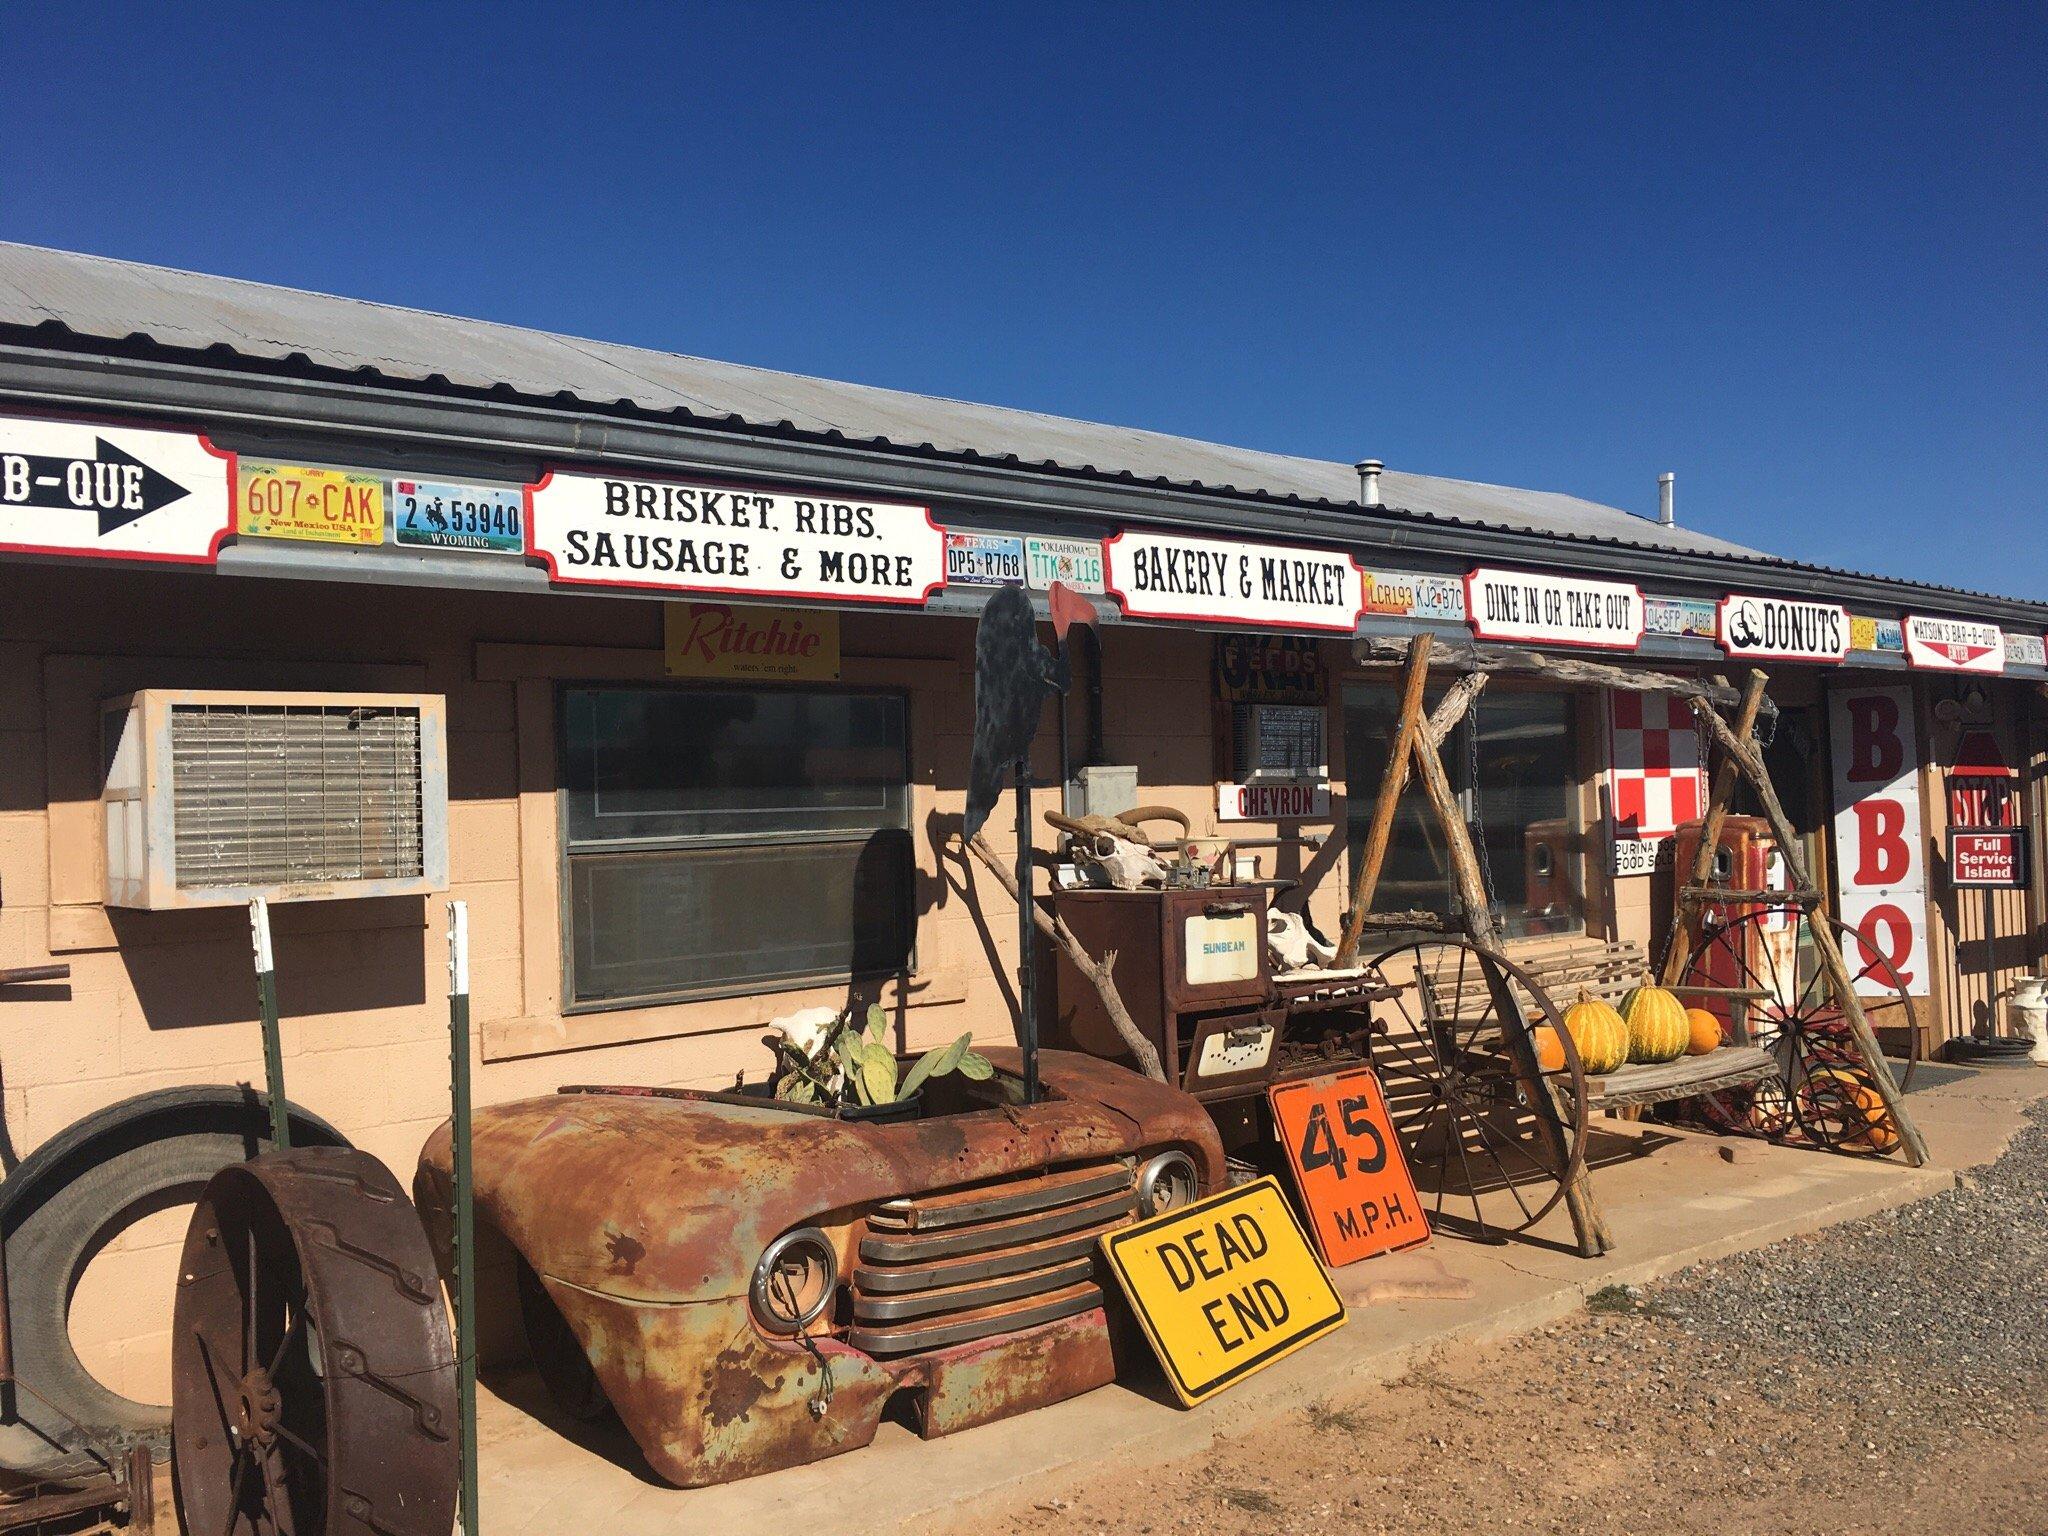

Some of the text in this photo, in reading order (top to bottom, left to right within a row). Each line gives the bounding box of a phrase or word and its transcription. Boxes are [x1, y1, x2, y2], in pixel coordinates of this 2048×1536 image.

[2, 455, 144, 510] B-QUE
[300, 469, 325, 478] CURRY
[248, 477, 375, 524] 607 CAK
[270, 519, 353, 531] New Mexico USA
[405, 497, 519, 536] 2 53940
[430, 532, 489, 548] WYOMING
[964, 537, 999, 550] TEXAS
[1043, 542, 1085, 555] OKLAHOMA
[566, 529, 913, 587] SAUSAGE & MORE
[985, 552, 1020, 577] R768
[1032, 554, 1101, 582] TTK 116
[1133, 546, 1345, 606] BAKERY & MARKET
[1370, 584, 1413, 606] LCR193
[1415, 585, 1437, 608] KJ2
[1485, 583, 1630, 631] DINE IN OR TAKE OUT
[681, 602, 821, 663] Ritchie
[1764, 602, 1840, 654] DONUTS
[1913, 620, 1949, 641] WATSON'S
[1952, 624, 1997, 647] BAR-B-QUE
[1238, 785, 1314, 817] CHEVRON
[1615, 842, 1654, 855] PURINA
[1974, 838, 2001, 851] Full
[1615, 856, 1644, 870] FOOD
[1959, 852, 2016, 865] Service
[1965, 865, 2011, 878] Island
[1202, 940, 1246, 955] SUNBEAM
[1300, 1093, 1387, 1181] 45
[1334, 1193, 1413, 1243] M.P.H.
[1156, 1212, 1269, 1293] DEAD
[1200, 1277, 1290, 1354] END
